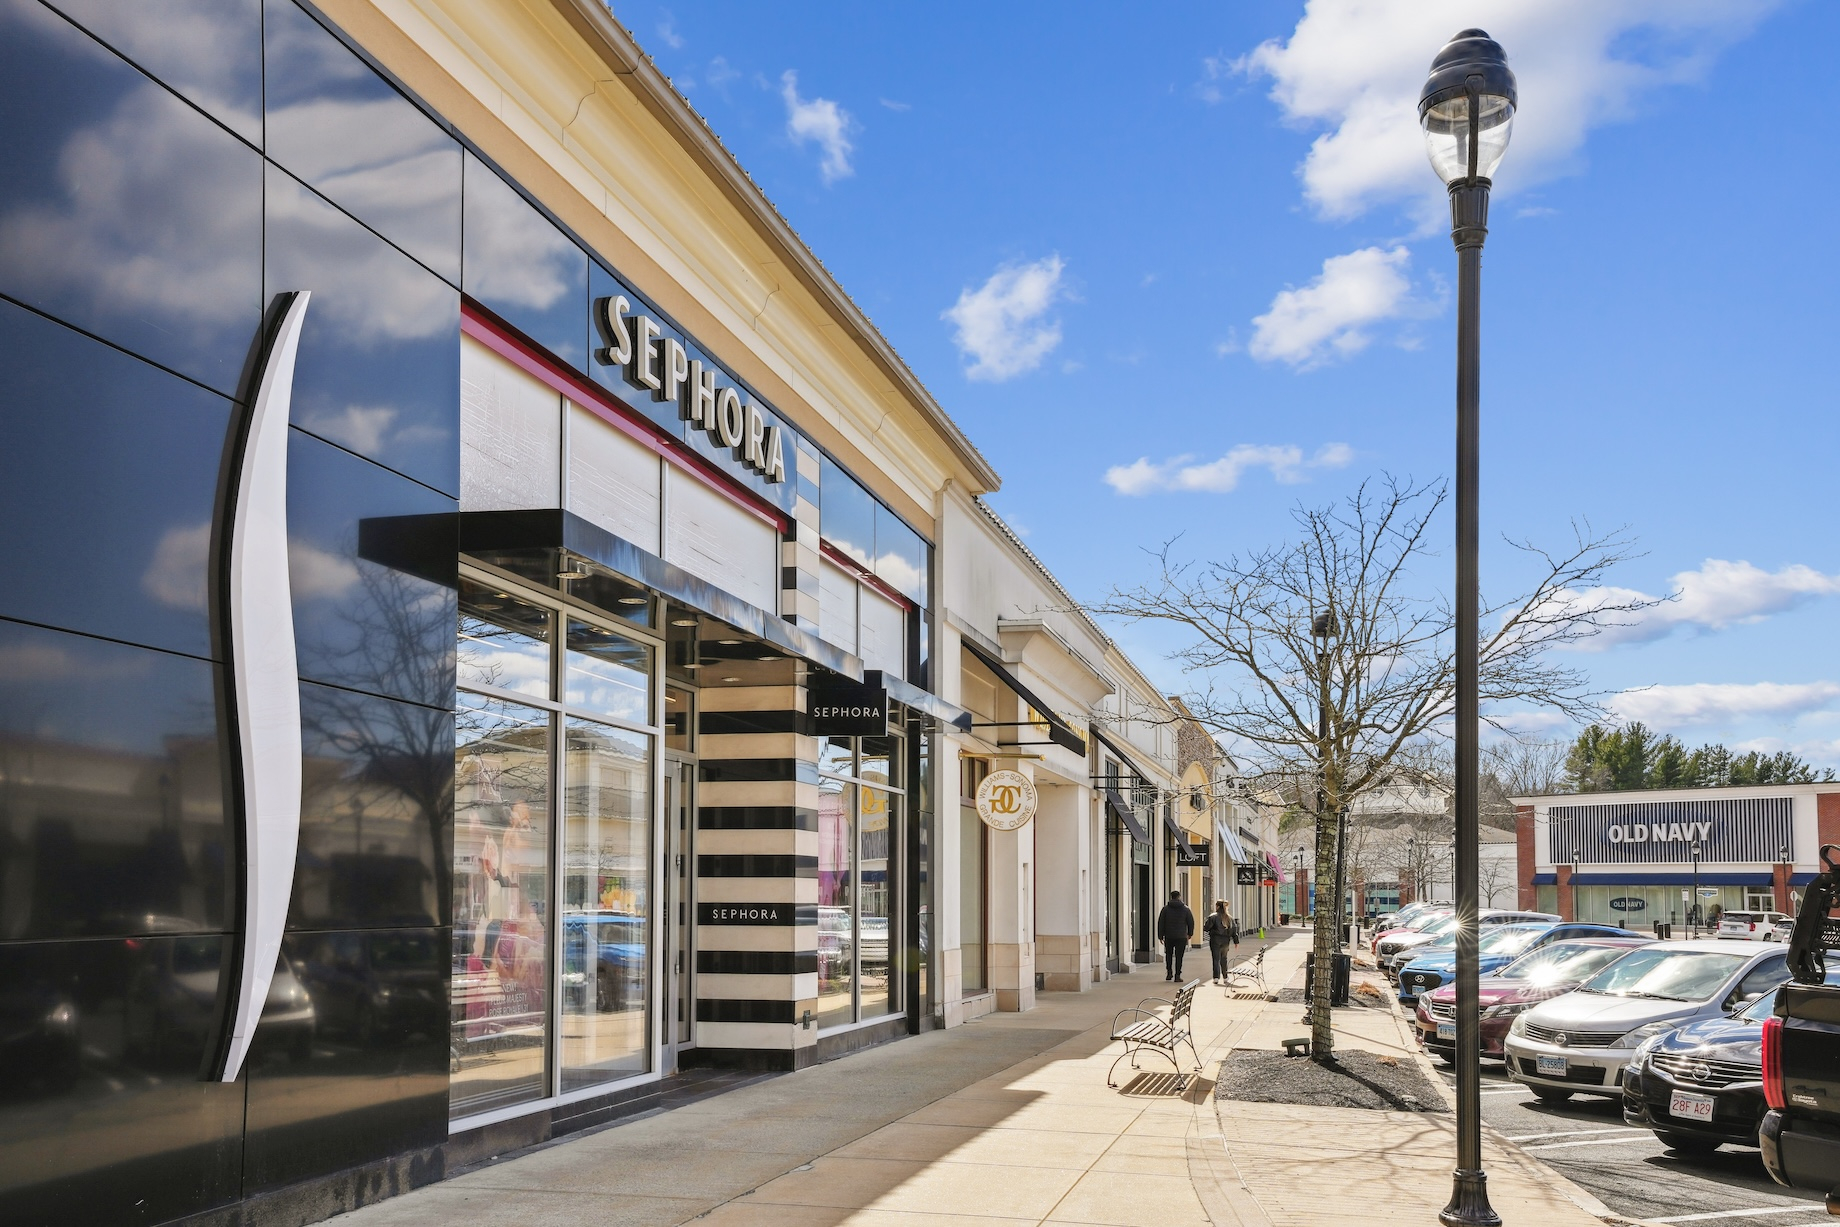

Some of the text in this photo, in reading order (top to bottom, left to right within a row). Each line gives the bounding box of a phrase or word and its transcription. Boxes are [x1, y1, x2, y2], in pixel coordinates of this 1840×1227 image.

[600, 295, 785, 484] SEPHORA
[814, 707, 880, 718] SEPHORA
[979, 772, 1033, 802] WILLIAMS-SONOMA
[980, 803, 1005, 829] GRANDE
[1008, 805, 1032, 828] CUISINE
[1608, 821, 1711, 843] OLD NAVY
[1179, 852, 1207, 862] LOFT
[712, 909, 778, 920] SEPHORA
[506, 993, 528, 1003] MAJESTY
[1694, 1102, 1711, 1115] A29
